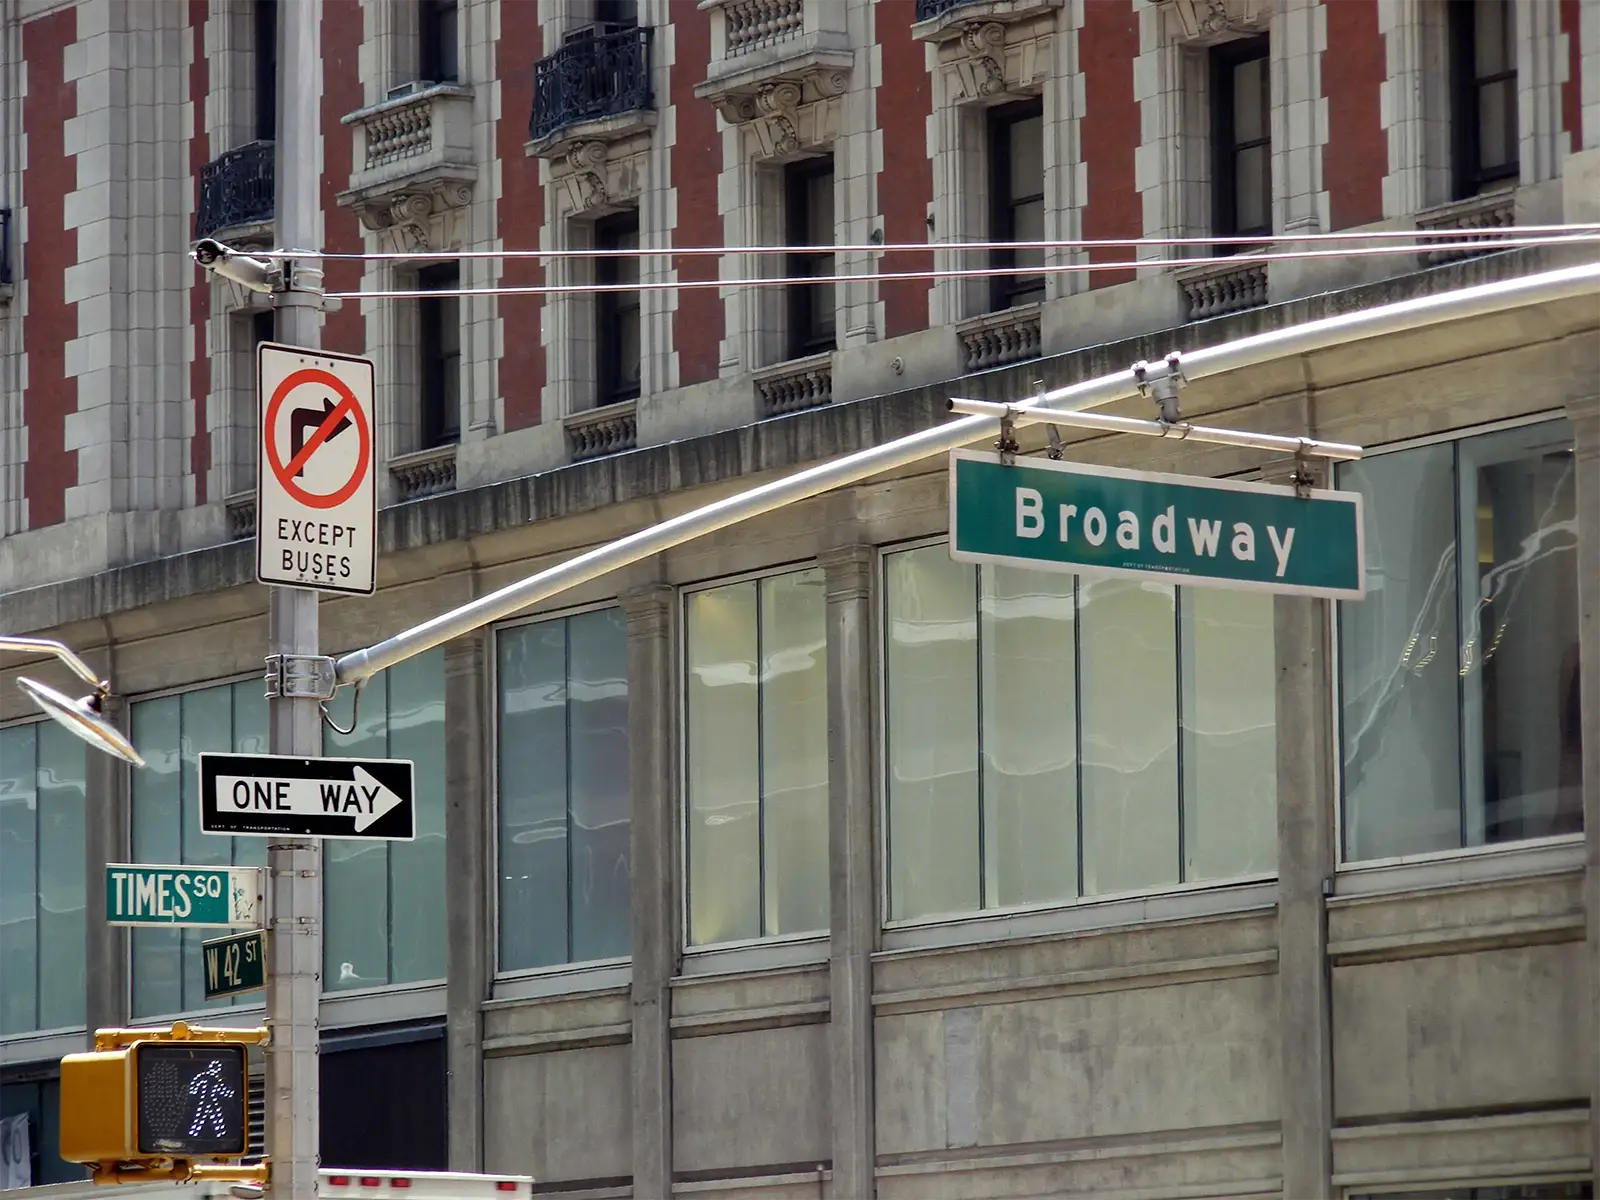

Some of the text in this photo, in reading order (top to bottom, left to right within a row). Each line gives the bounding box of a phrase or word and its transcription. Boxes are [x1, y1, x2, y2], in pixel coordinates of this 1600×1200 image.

[278, 518, 356, 548] EXCEPT
[1015, 486, 1296, 577] Broadway
[282, 549, 350, 578] BUSES
[232, 780, 381, 814] ONE WAY
[111, 872, 222, 918] TIMES SQ
[206, 940, 257, 991] W 42 ST
